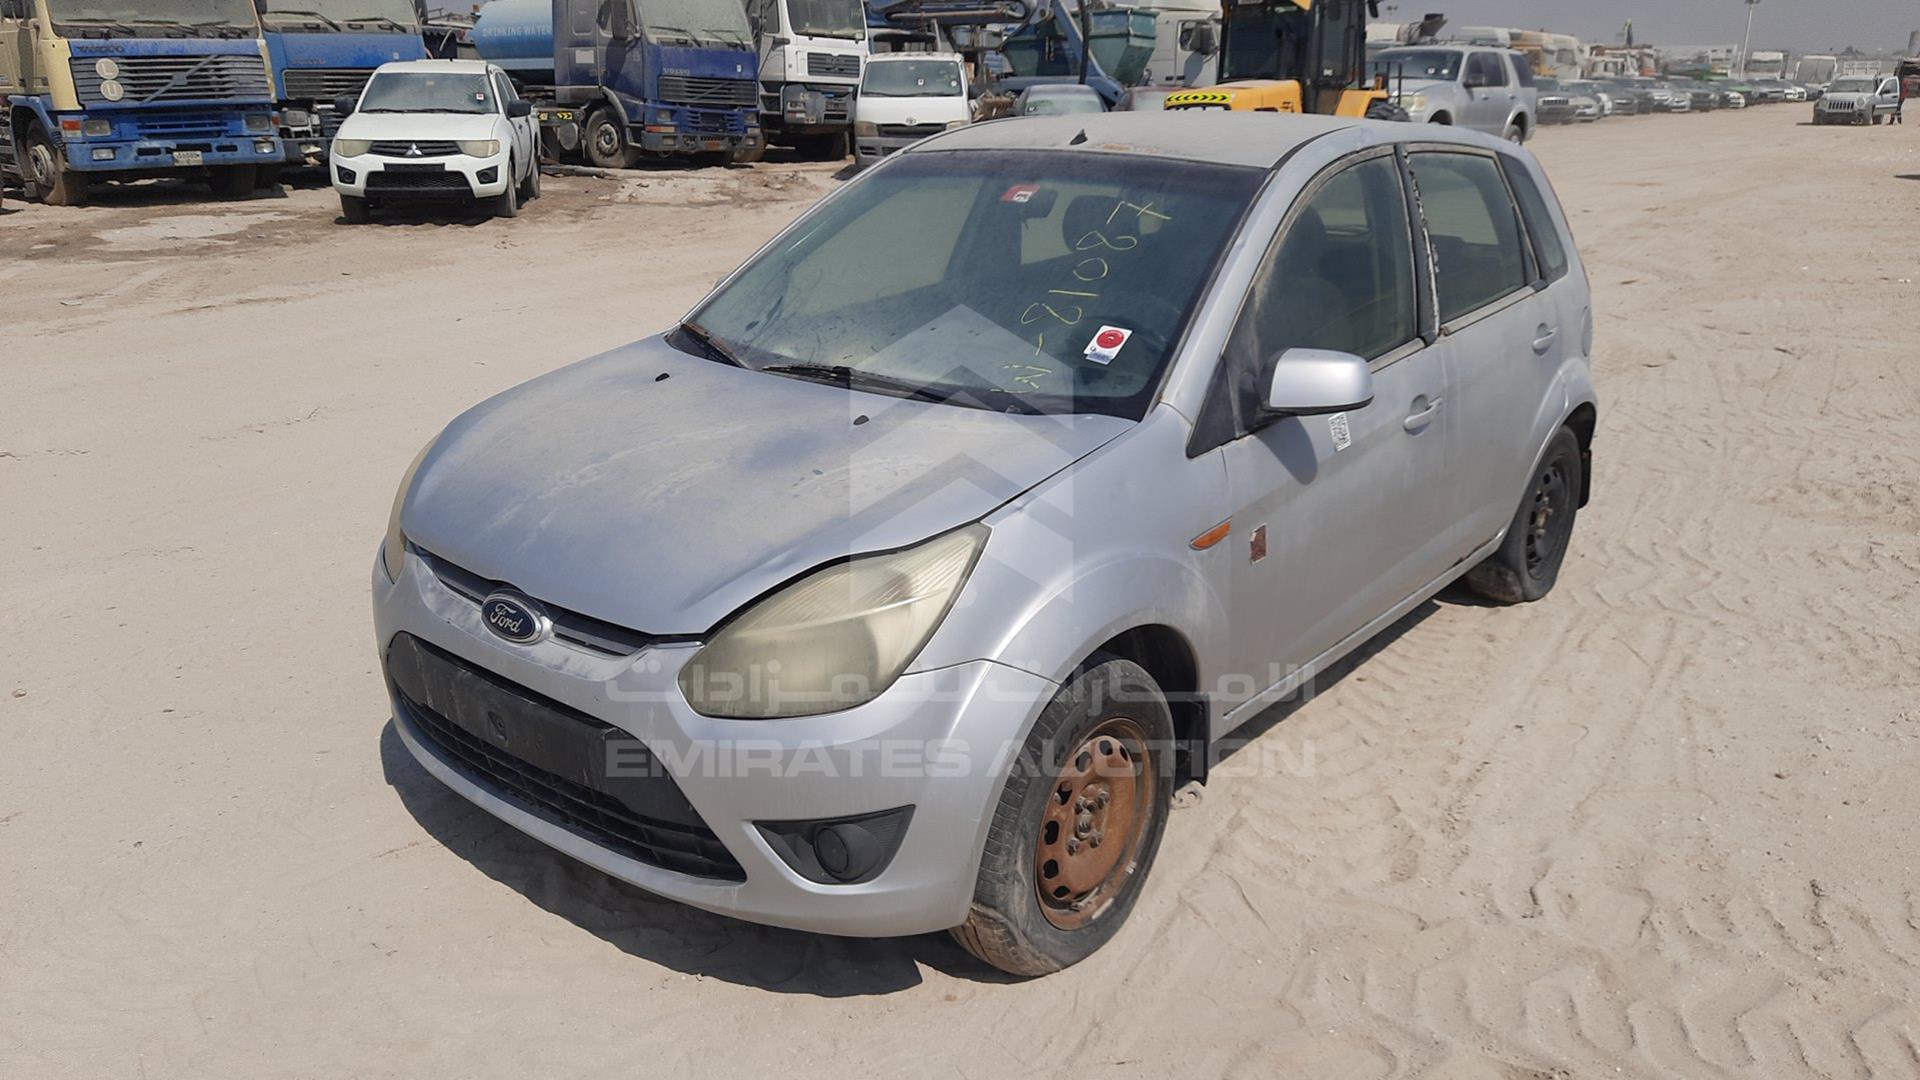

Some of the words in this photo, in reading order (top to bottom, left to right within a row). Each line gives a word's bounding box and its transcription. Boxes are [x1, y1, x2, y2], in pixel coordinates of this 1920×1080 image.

[482, 24, 522, 38] DRINKING
[101, 61, 113, 75] L
[106, 83, 119, 97] U
[489, 603, 524, 633] Ford
